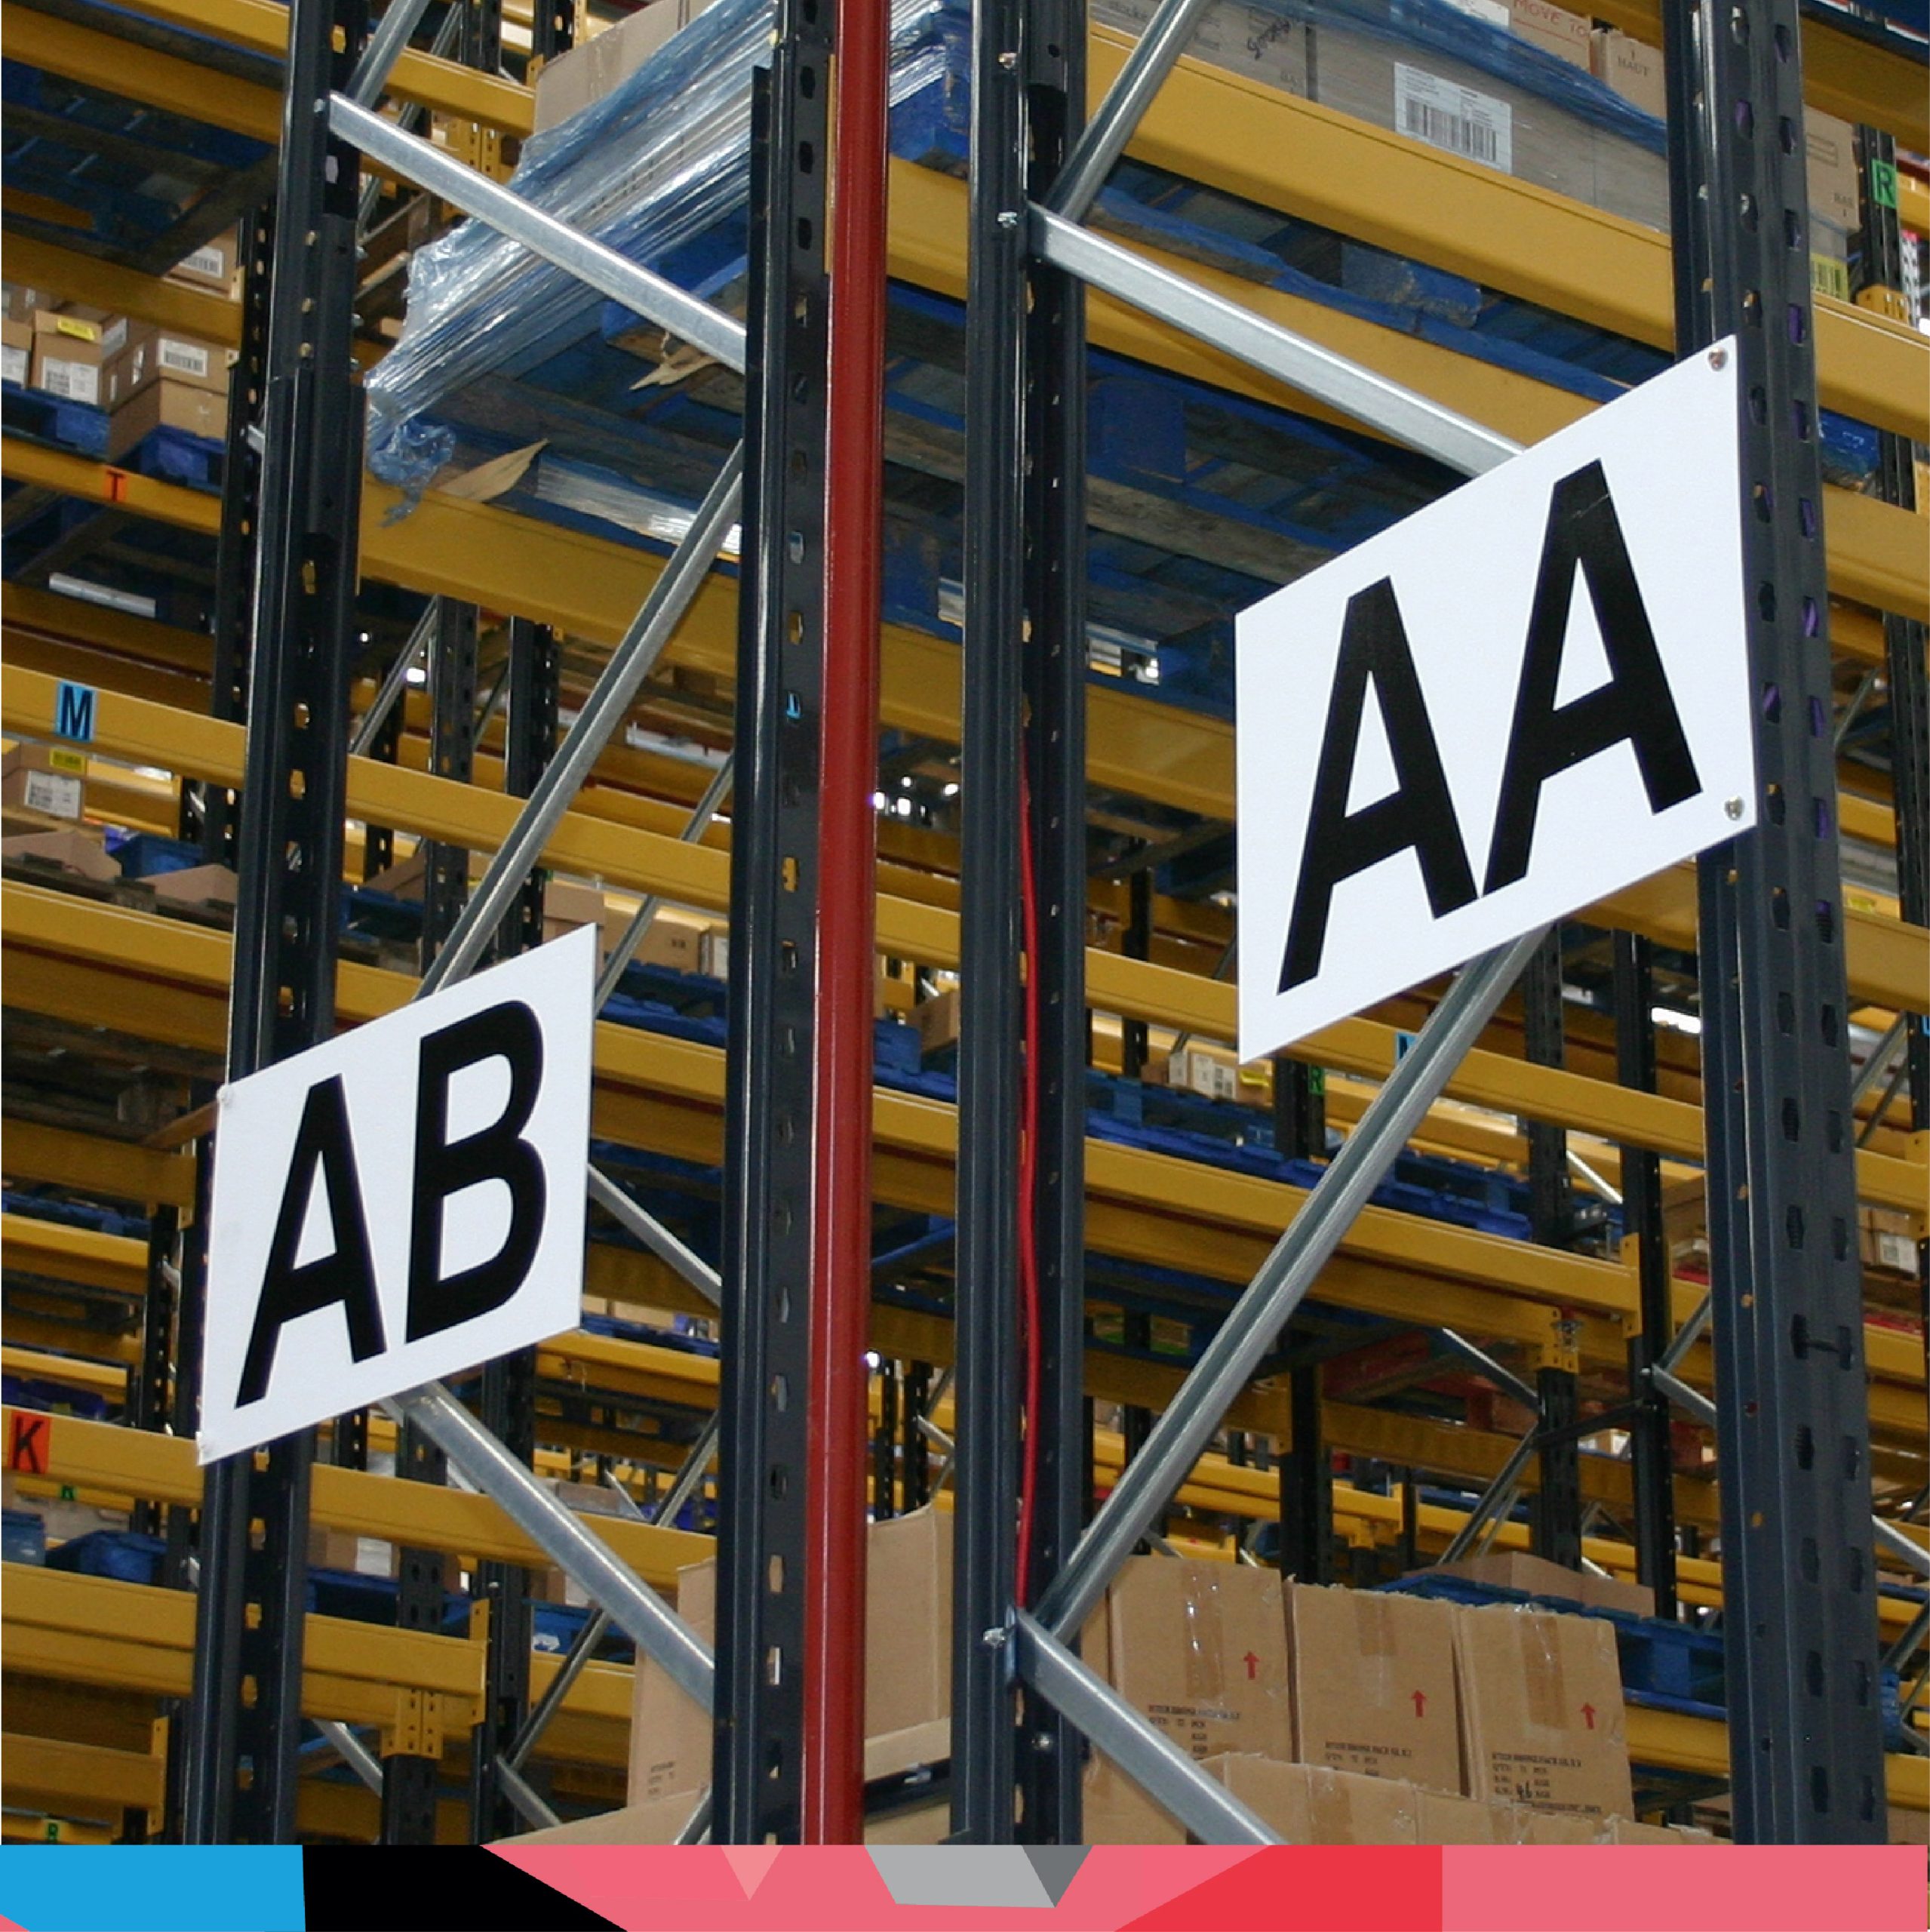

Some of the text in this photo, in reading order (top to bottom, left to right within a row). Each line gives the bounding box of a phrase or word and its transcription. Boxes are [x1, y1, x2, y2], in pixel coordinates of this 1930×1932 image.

[1514, 0, 1562, 24] MOVE
[1618, 55, 1649, 76] HAUT
[1876, 167, 1896, 205] R
[106, 469, 127, 503] T
[61, 685, 93, 740] M
[1277, 457, 1703, 995] AA
[1310, 1066, 1323, 1092] R
[235, 1000, 548, 1409] AB
[12, 1416, 44, 1473] K
